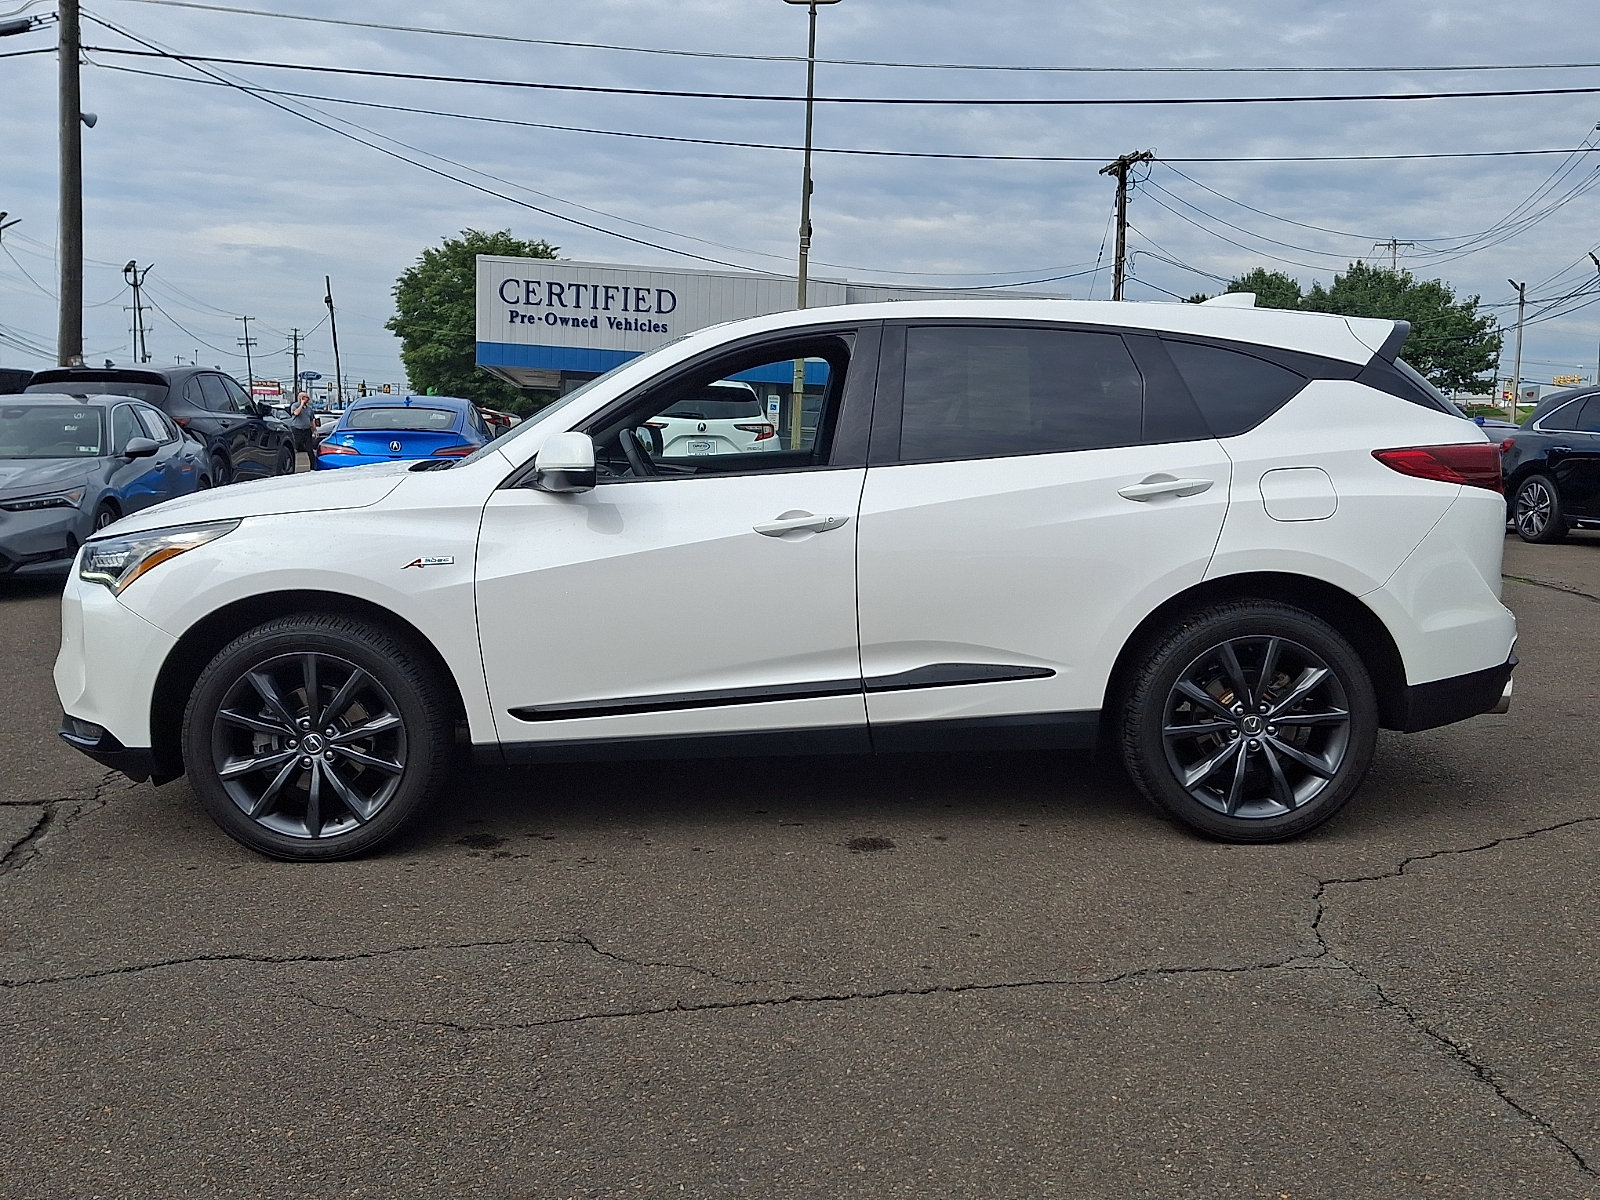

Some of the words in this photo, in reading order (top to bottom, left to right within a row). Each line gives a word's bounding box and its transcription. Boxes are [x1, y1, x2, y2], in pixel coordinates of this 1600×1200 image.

[498, 278, 677, 314] CERTIFIED
[508, 309, 599, 328] Pre-Owned
[606, 316, 668, 333] Vehicles
